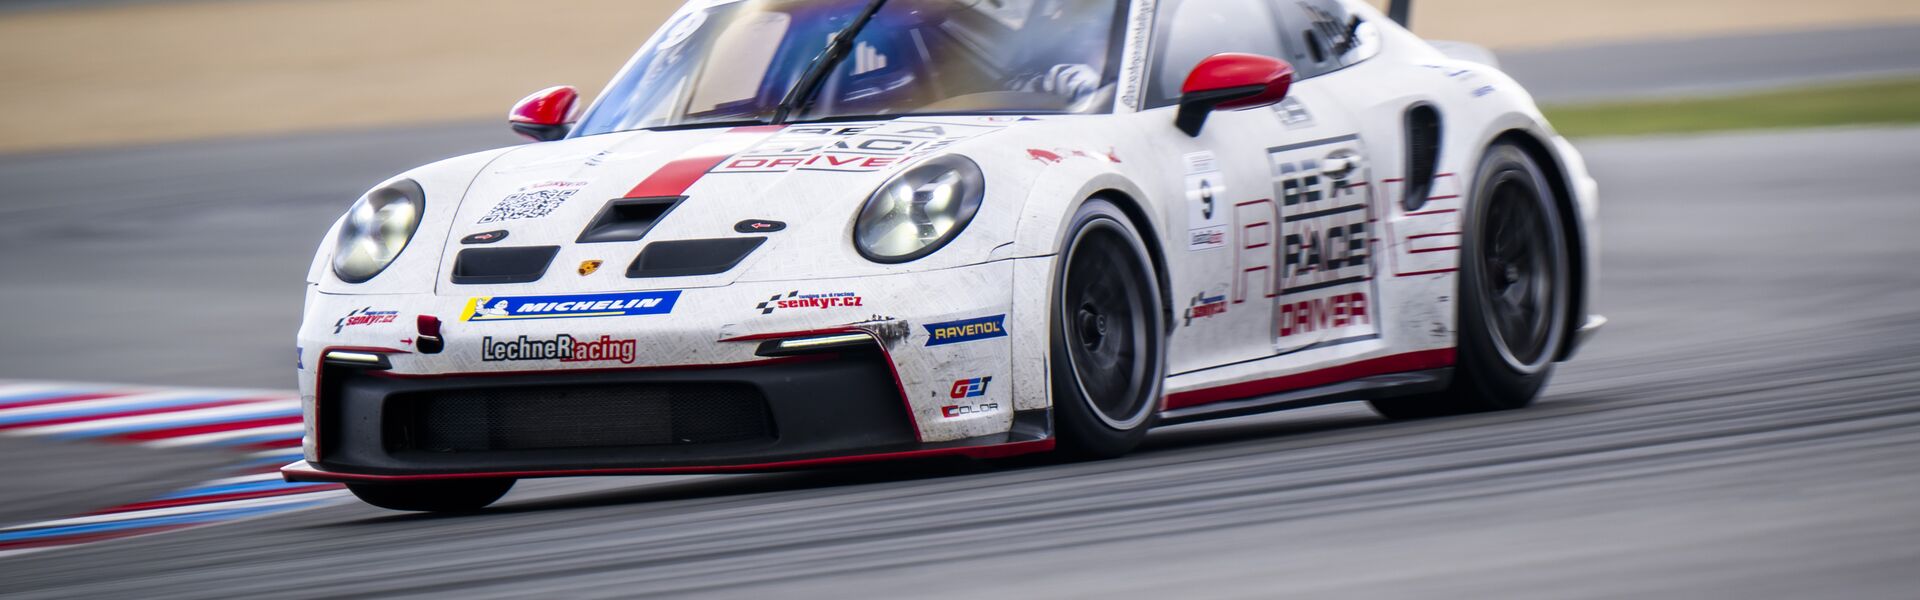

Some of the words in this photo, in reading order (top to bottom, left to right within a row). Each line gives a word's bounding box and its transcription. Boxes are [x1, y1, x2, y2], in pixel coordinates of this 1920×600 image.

[1199, 179, 1215, 220] 9
[1281, 221, 1365, 279] RACE
[516, 298, 664, 313] MICHELIN
[777, 297, 863, 309] senkyr.cz
[1278, 291, 1370, 338] DRIVER
[935, 322, 1001, 340] RAVENOL
[482, 334, 637, 364] LechneRacing
[950, 376, 992, 399] GET
[941, 403, 998, 418] COLOR
